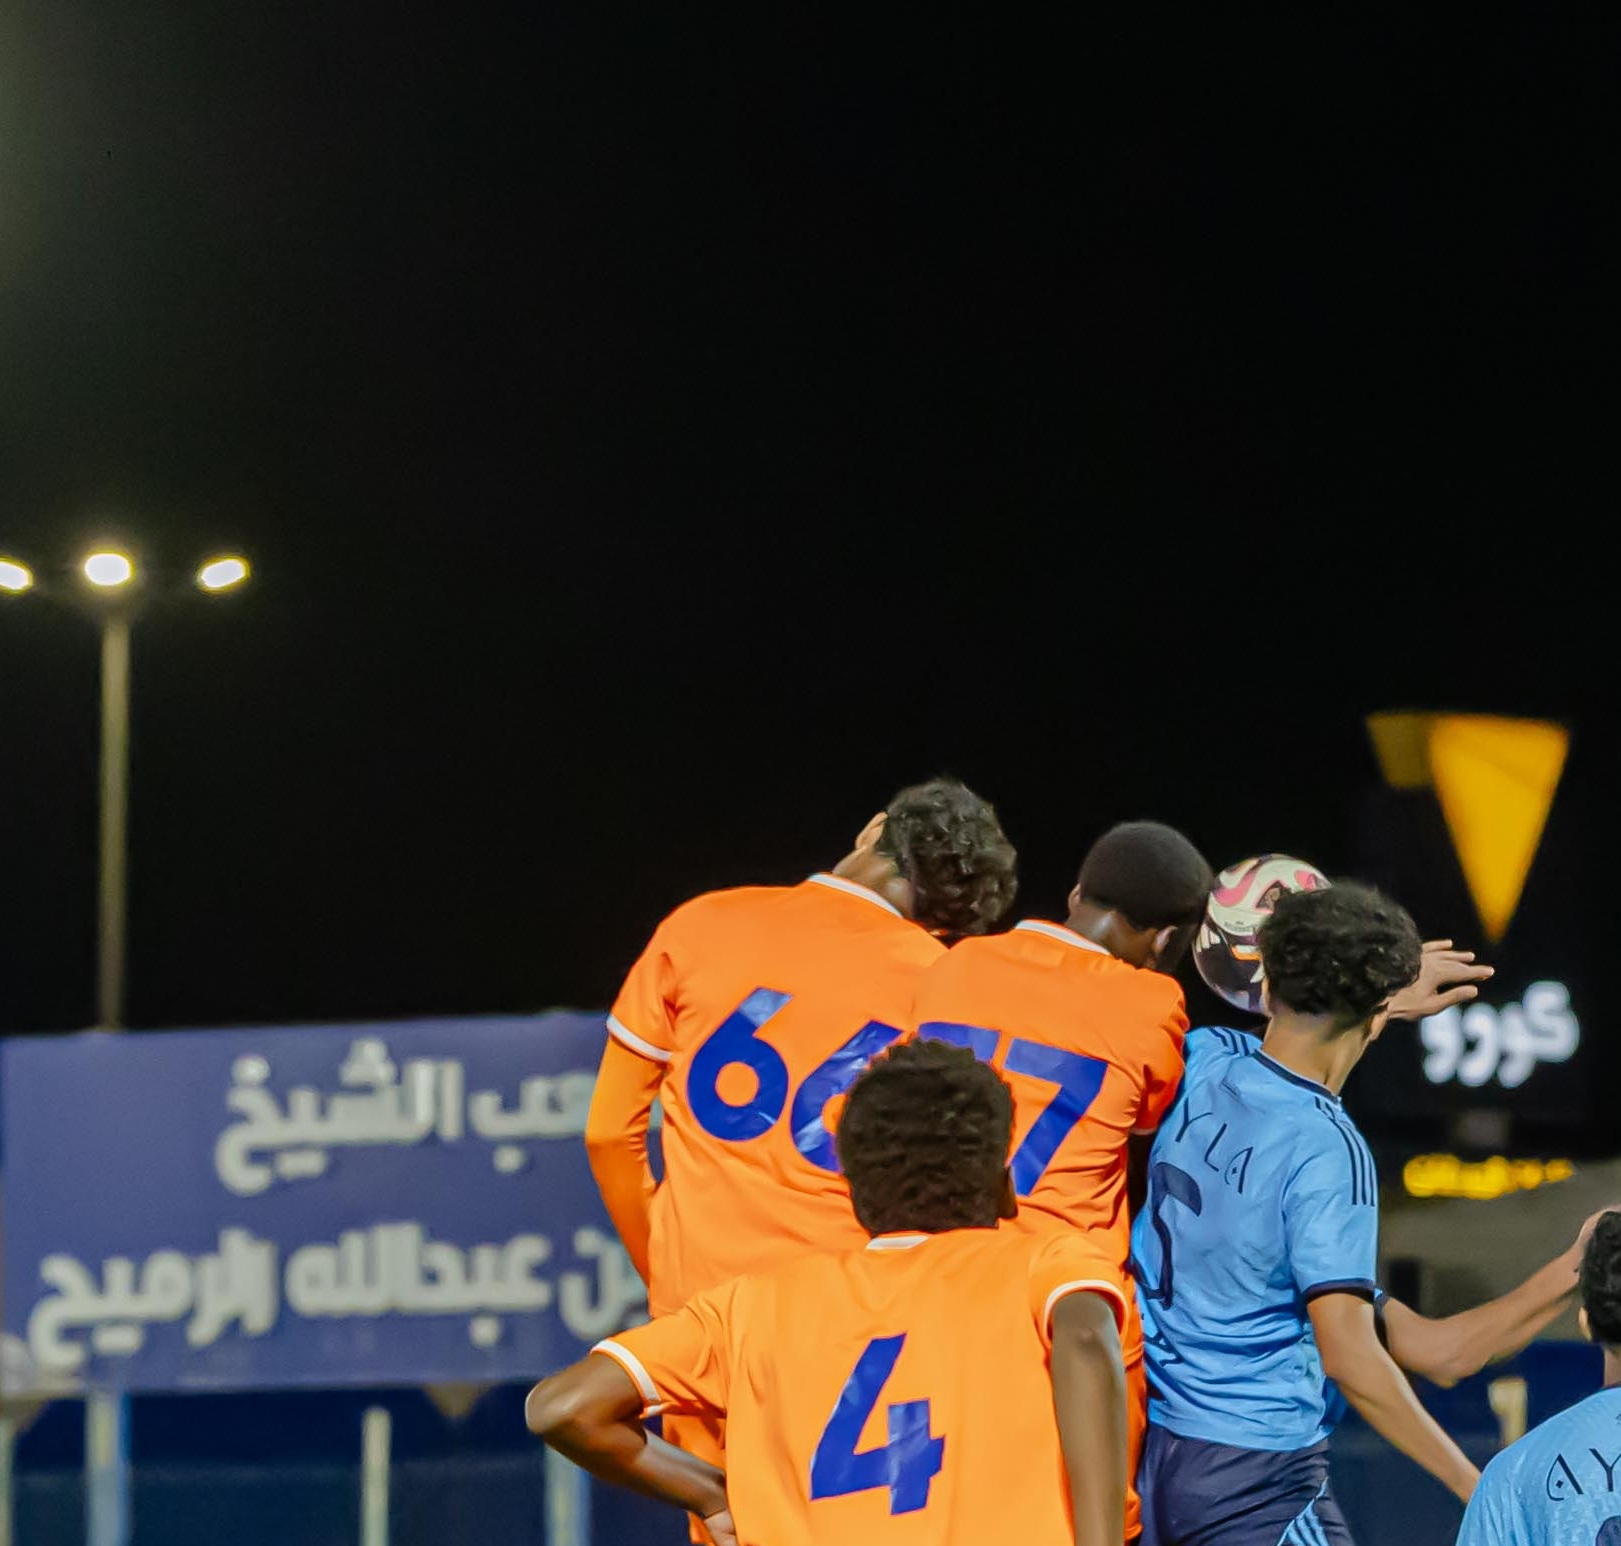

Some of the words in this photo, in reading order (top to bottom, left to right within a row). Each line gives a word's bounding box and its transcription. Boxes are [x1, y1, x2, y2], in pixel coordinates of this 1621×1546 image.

[214, 1039, 465, 1196] الشيخ
[1174, 1095, 1254, 1194] YLA
[27, 1226, 281, 1373] الرميح
[284, 1218, 554, 1347] عبدالله
[810, 1331, 947, 1516] 4
